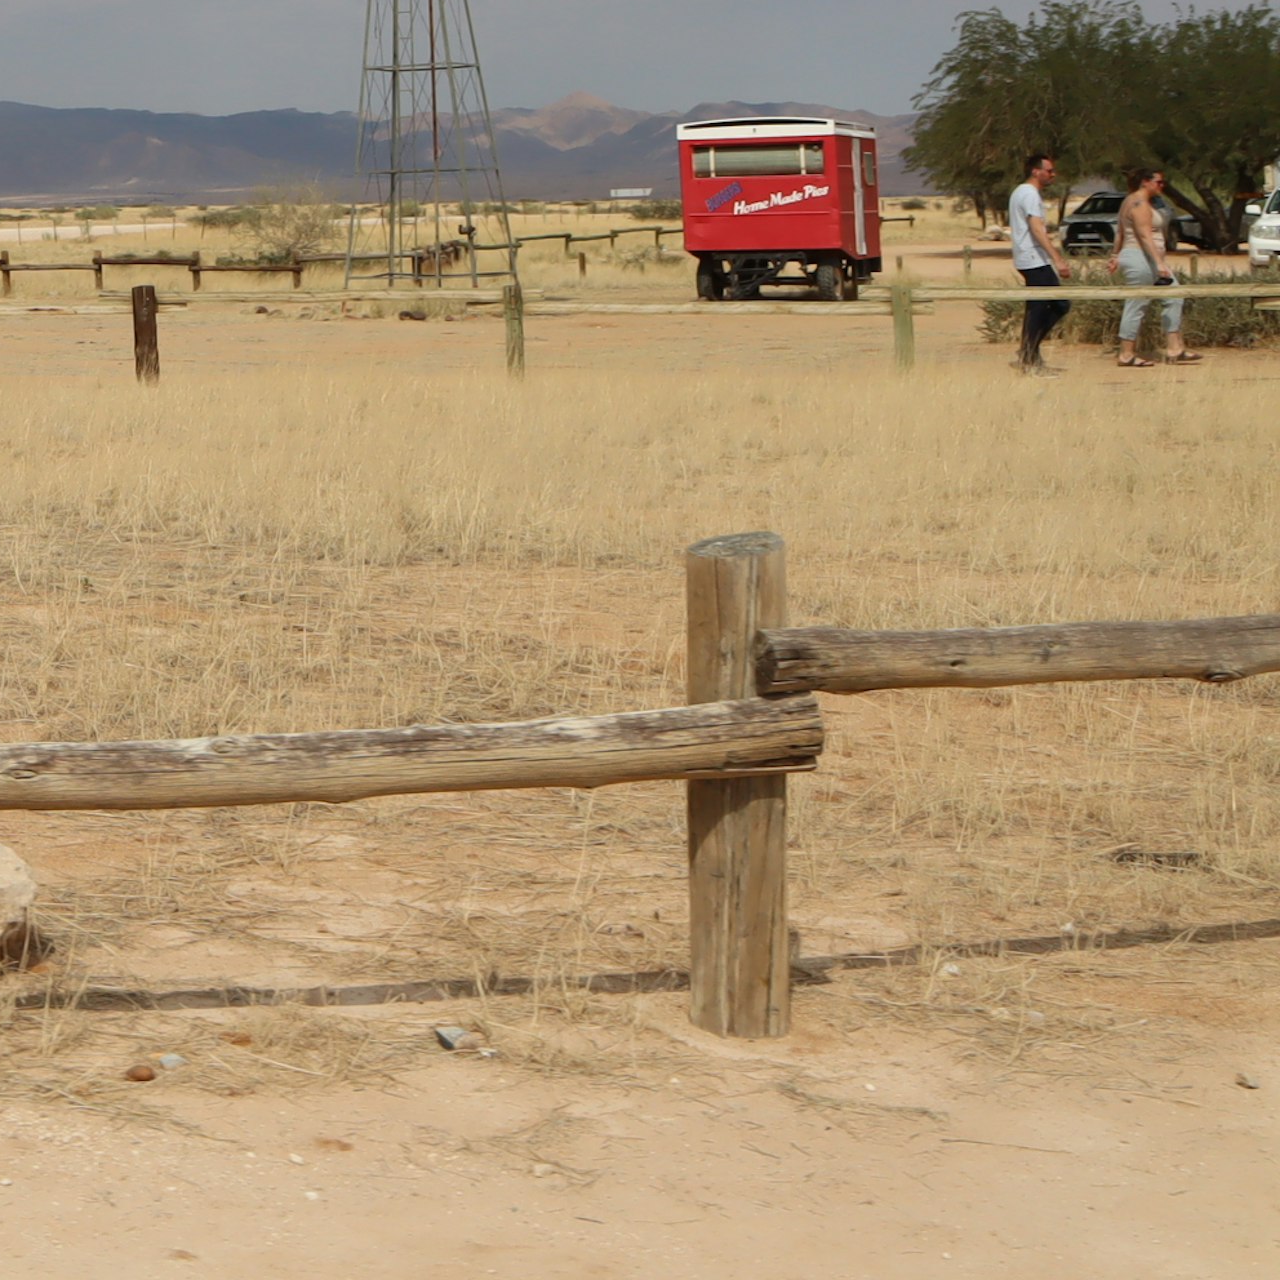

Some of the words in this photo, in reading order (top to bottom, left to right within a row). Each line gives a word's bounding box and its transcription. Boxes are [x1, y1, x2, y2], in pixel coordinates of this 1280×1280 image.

[734, 200, 769, 215] Home
[770, 190, 803, 207] Made
[803, 184, 830, 199] Pies
